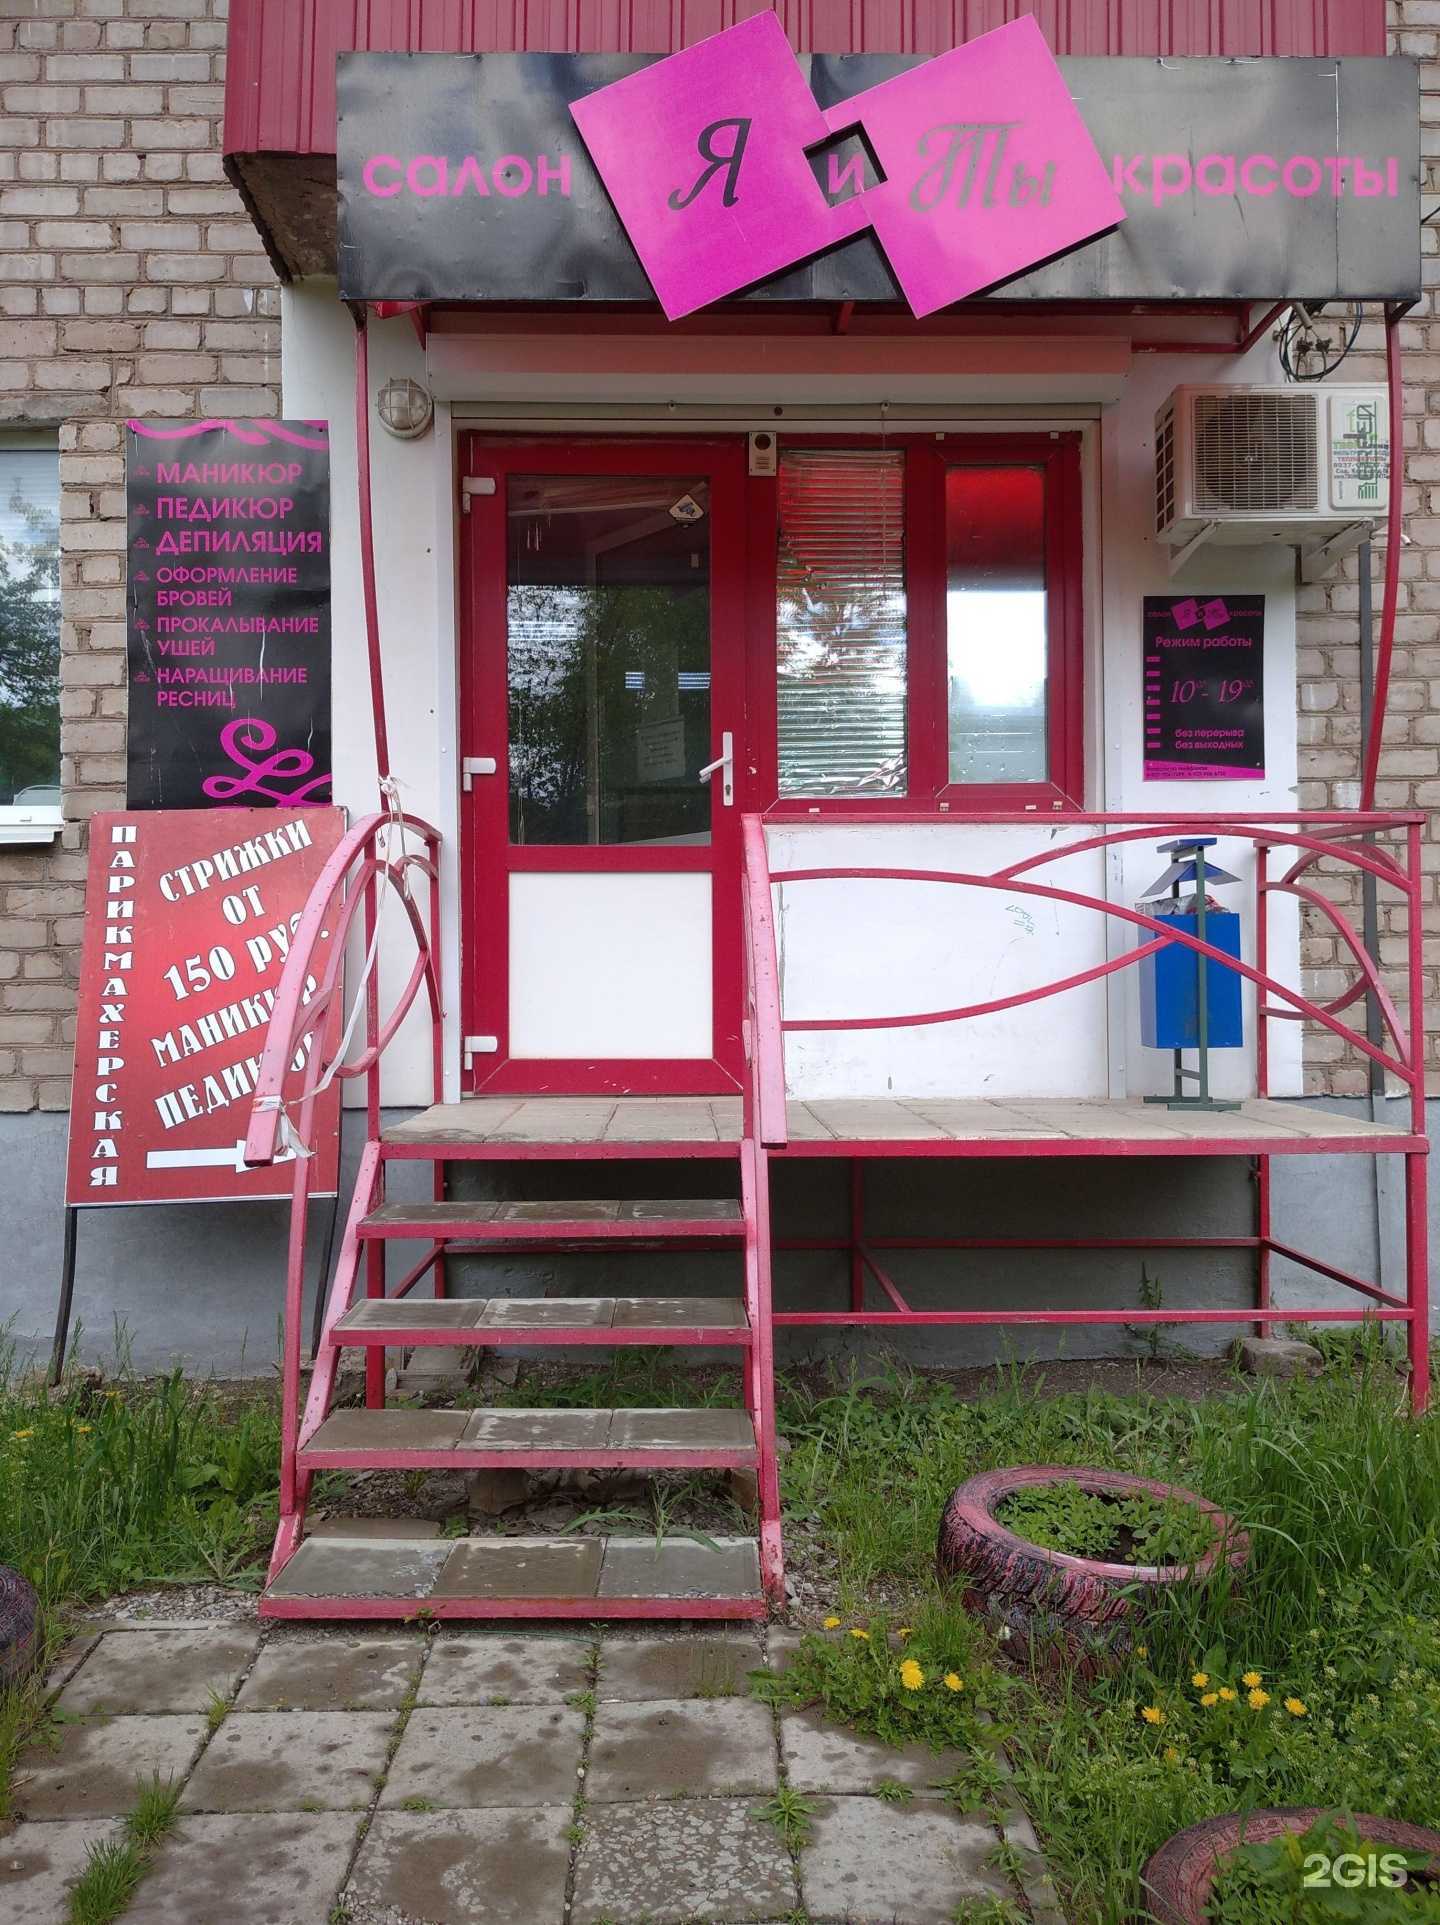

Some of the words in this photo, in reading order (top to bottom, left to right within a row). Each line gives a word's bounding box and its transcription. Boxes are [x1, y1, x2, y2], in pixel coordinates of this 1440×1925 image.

[362, 150, 573, 198] салон
[667, 117, 752, 209] Я
[828, 153, 865, 195] и
[908, 122, 1057, 214] Ты
[1112, 153, 1399, 208] красоты
[156, 463, 303, 486] МАНИКЮР
[156, 497, 294, 522] ПЕДИКЮР
[155, 531, 323, 556] ДЕПИЛЯЦИЯ
[156, 567, 297, 584] ОФОРМЛЕНИЕ
[156, 587, 233, 607] БРОВЕЙ
[156, 616, 319, 633] ПРОКАЛЫВАНИЕ
[156, 637, 216, 656] УШЕЙ
[1155, 636, 1201, 648] Режим
[1203, 636, 1252, 649] работы
[156, 667, 308, 687] НАРАЩИВАНИЕ
[156, 691, 236, 709] РЕСНИЦ
[1175, 729, 1193, 738] без
[1194, 729, 1244, 739] перерыва
[1175, 741, 1193, 750] без
[1194, 741, 1244, 751] выходных
[159, 819, 313, 902] СТРИЖКИ
[222, 884, 266, 926] ОТ
[163, 945, 236, 1001] 150
[89, 825, 138, 1187] ПАРИКМАХЕРСКАЯ
[150, 974, 317, 1068] МАНИКР
